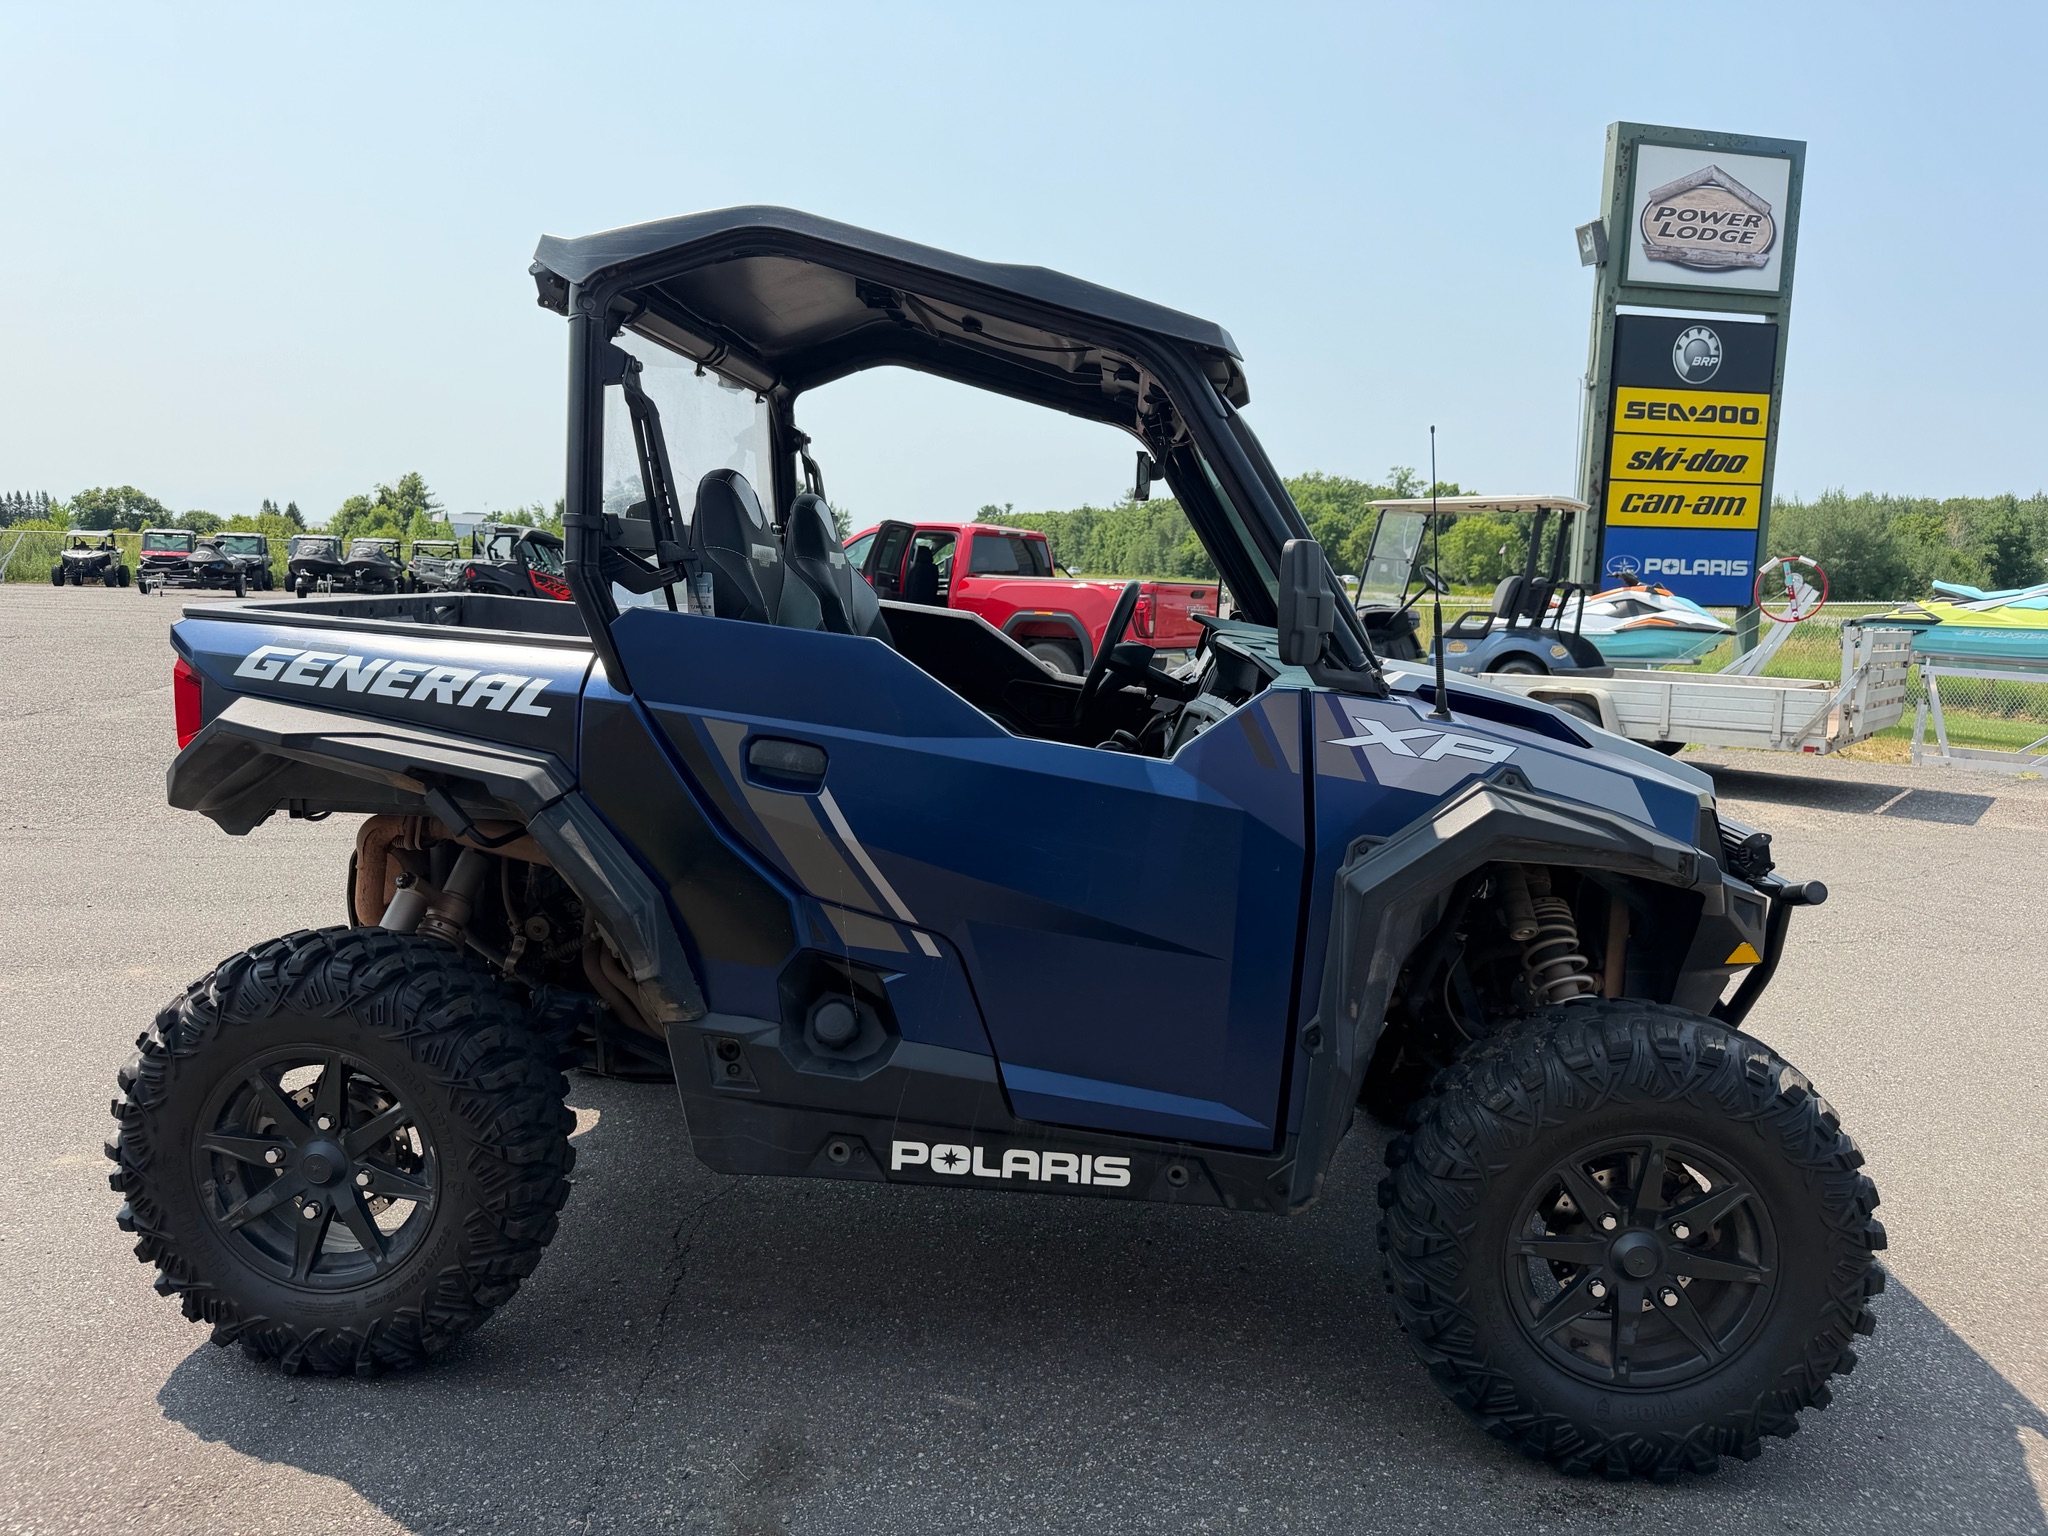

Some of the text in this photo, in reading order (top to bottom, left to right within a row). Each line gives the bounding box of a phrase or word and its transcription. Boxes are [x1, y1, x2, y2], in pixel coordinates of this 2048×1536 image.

[1652, 206, 1763, 229] POWER
[1657, 221, 1757, 245] LODGE
[1691, 356, 1719, 367] BRP
[1626, 446, 1750, 474] ski-doo
[1620, 493, 1747, 517] can-am
[1643, 557, 1749, 577] POLARIS
[233, 644, 554, 718] GENERAL
[1321, 716, 1519, 764] XP
[890, 1140, 1132, 1188] POLARIS
